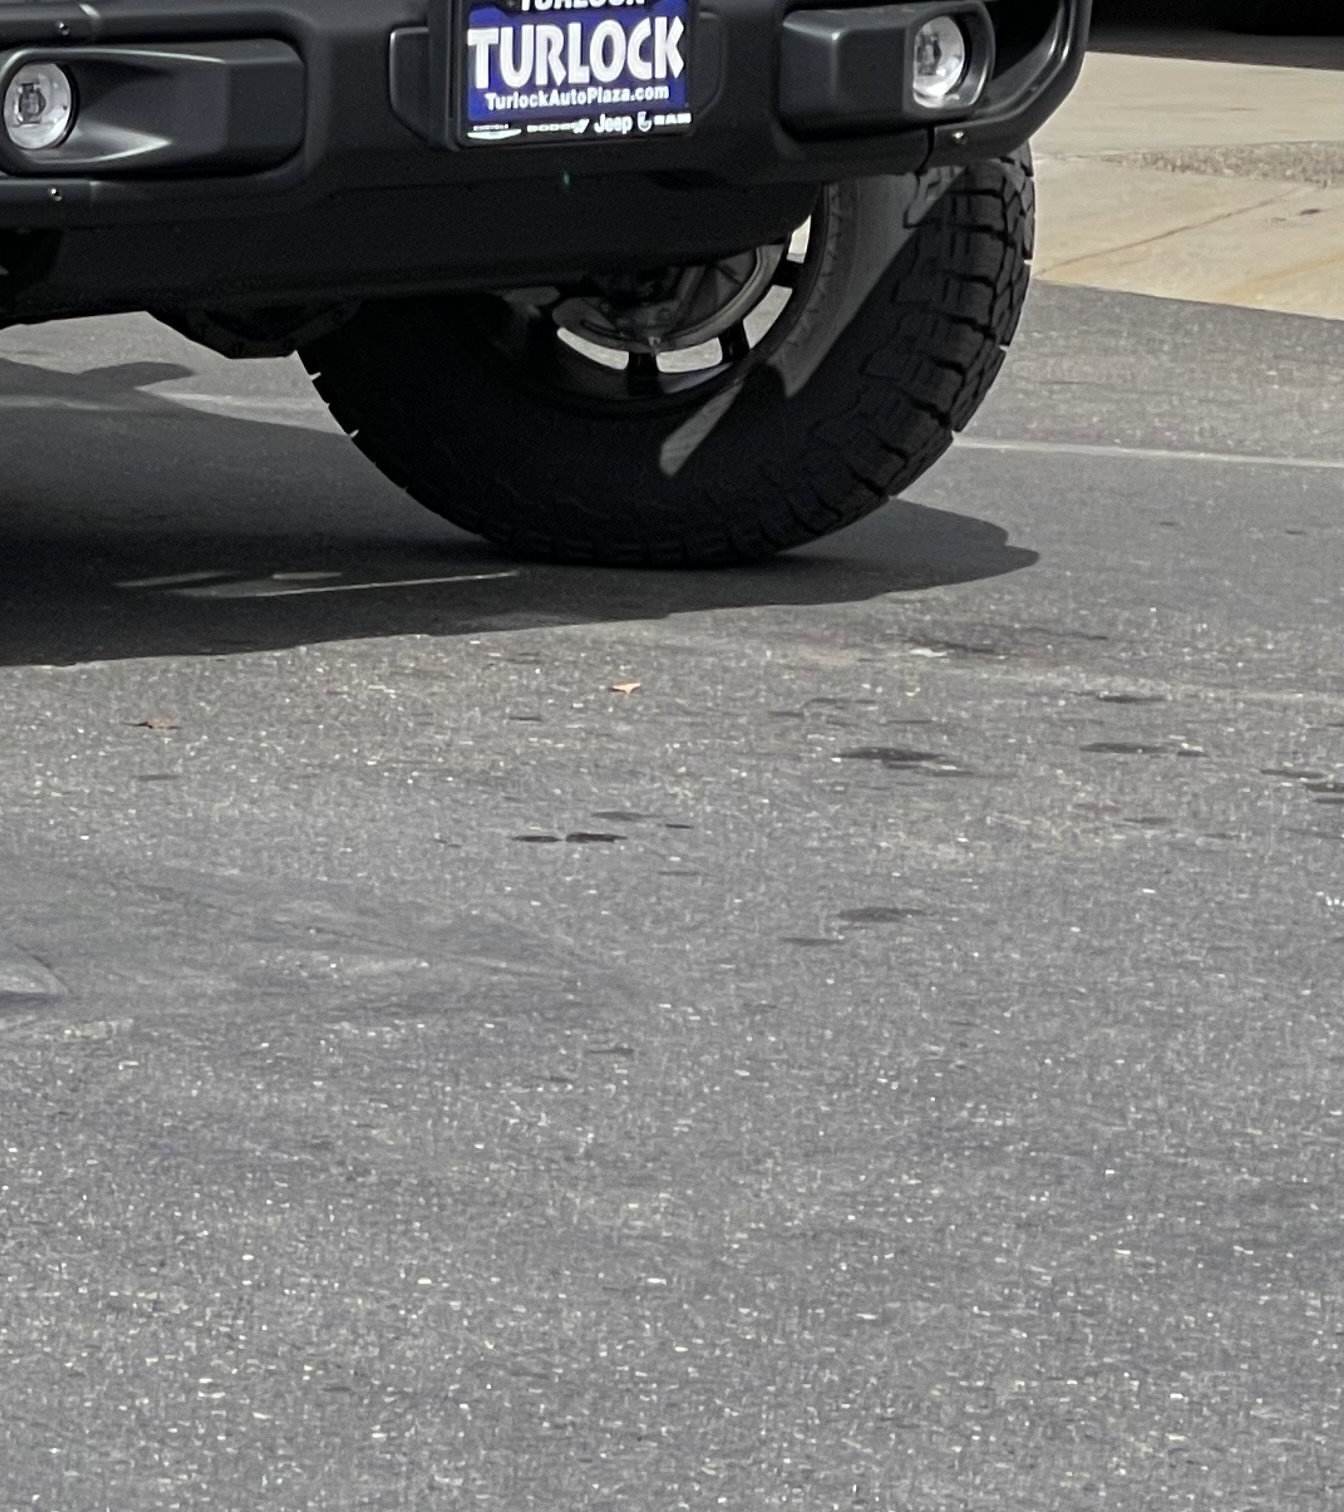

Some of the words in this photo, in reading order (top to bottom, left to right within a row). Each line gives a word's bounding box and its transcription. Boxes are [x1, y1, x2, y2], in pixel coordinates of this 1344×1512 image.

[466, 15, 685, 90] TURLOCK
[484, 85, 670, 112] TurlockAutoPlaza.com
[593, 113, 634, 135] Jeep
